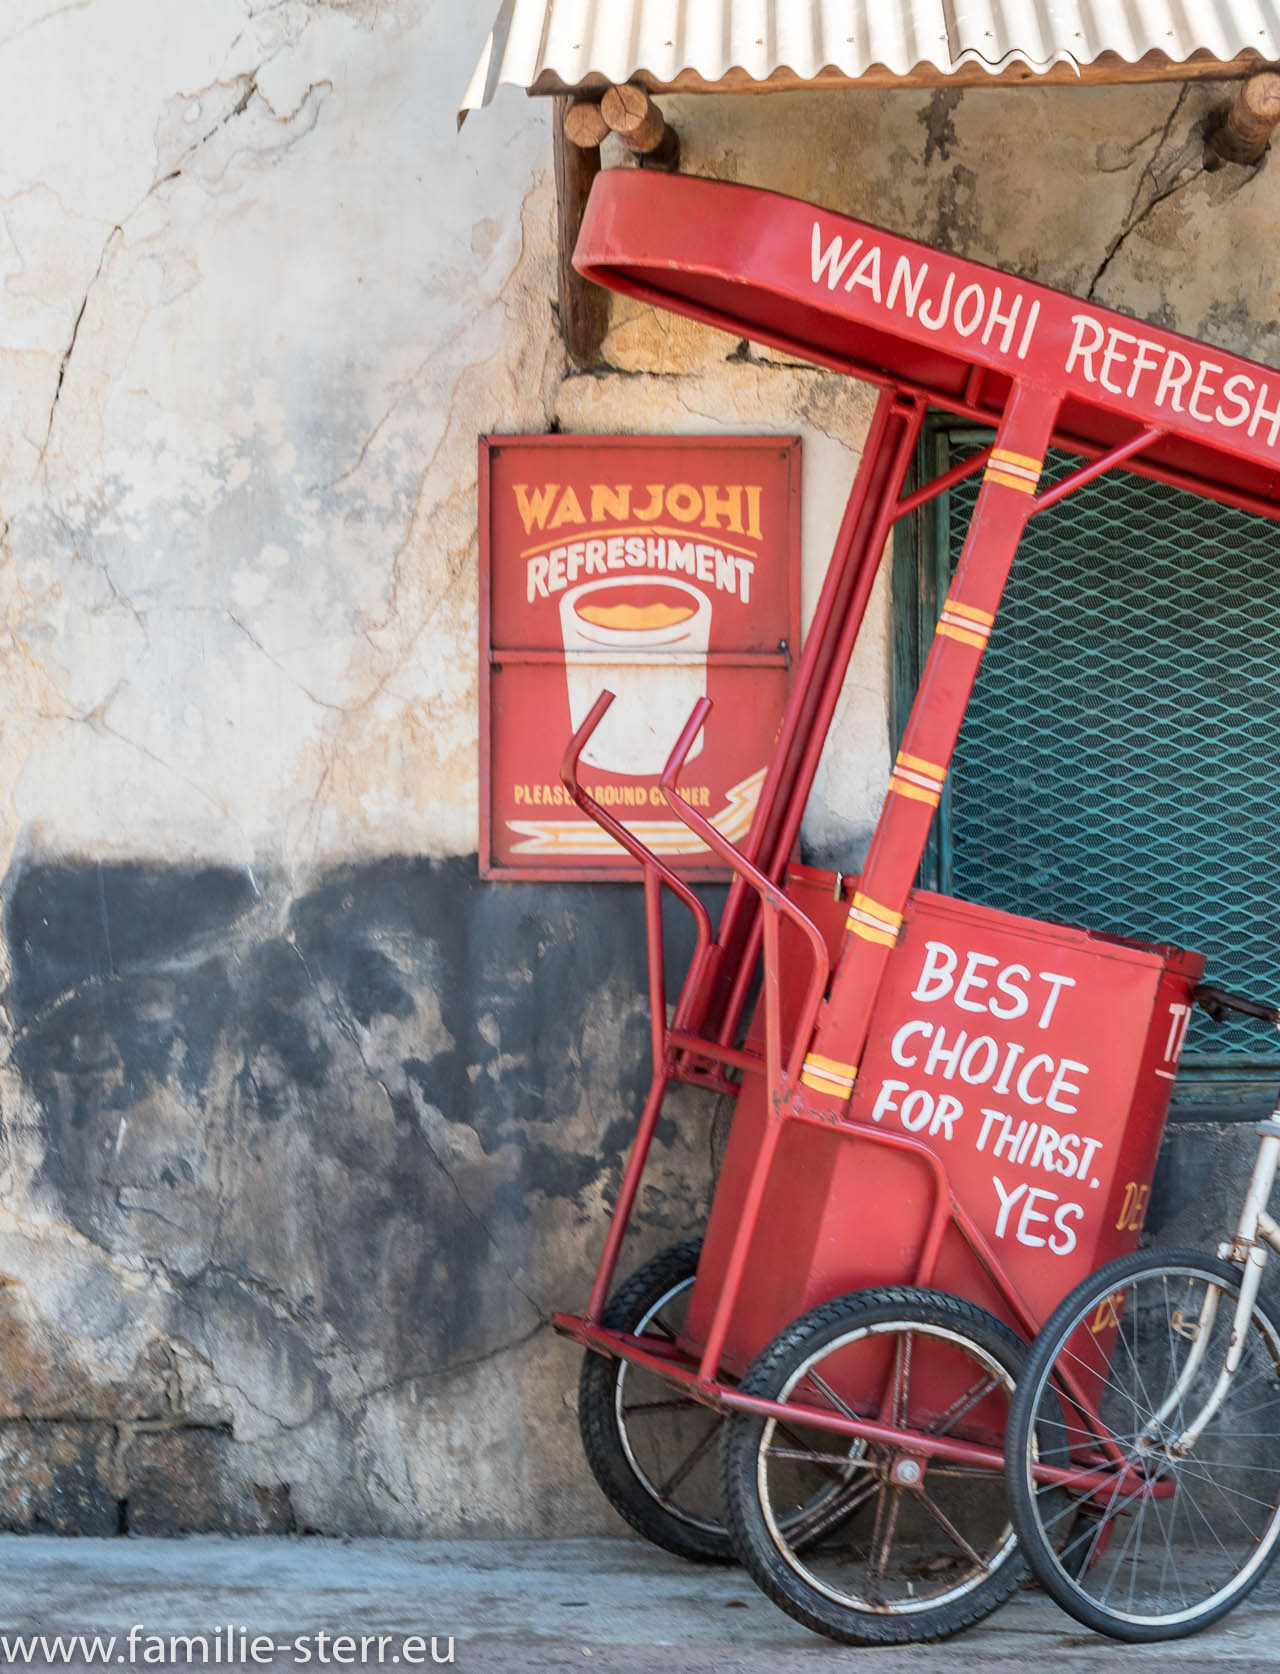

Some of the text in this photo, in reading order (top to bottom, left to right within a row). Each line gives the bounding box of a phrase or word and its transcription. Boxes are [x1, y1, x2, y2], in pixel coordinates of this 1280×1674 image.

[810, 221, 1041, 359] WANJOHI
[512, 483, 763, 540] WANJOHI
[526, 536, 754, 604] REFRESHMENT
[650, 786, 710, 807] CNER
[910, 941, 1077, 1030] BEST
[890, 1020, 1090, 1115] CHOICE
[871, 1079, 1103, 1189] FOR THIRST,
[992, 1175, 1085, 1256] YES
